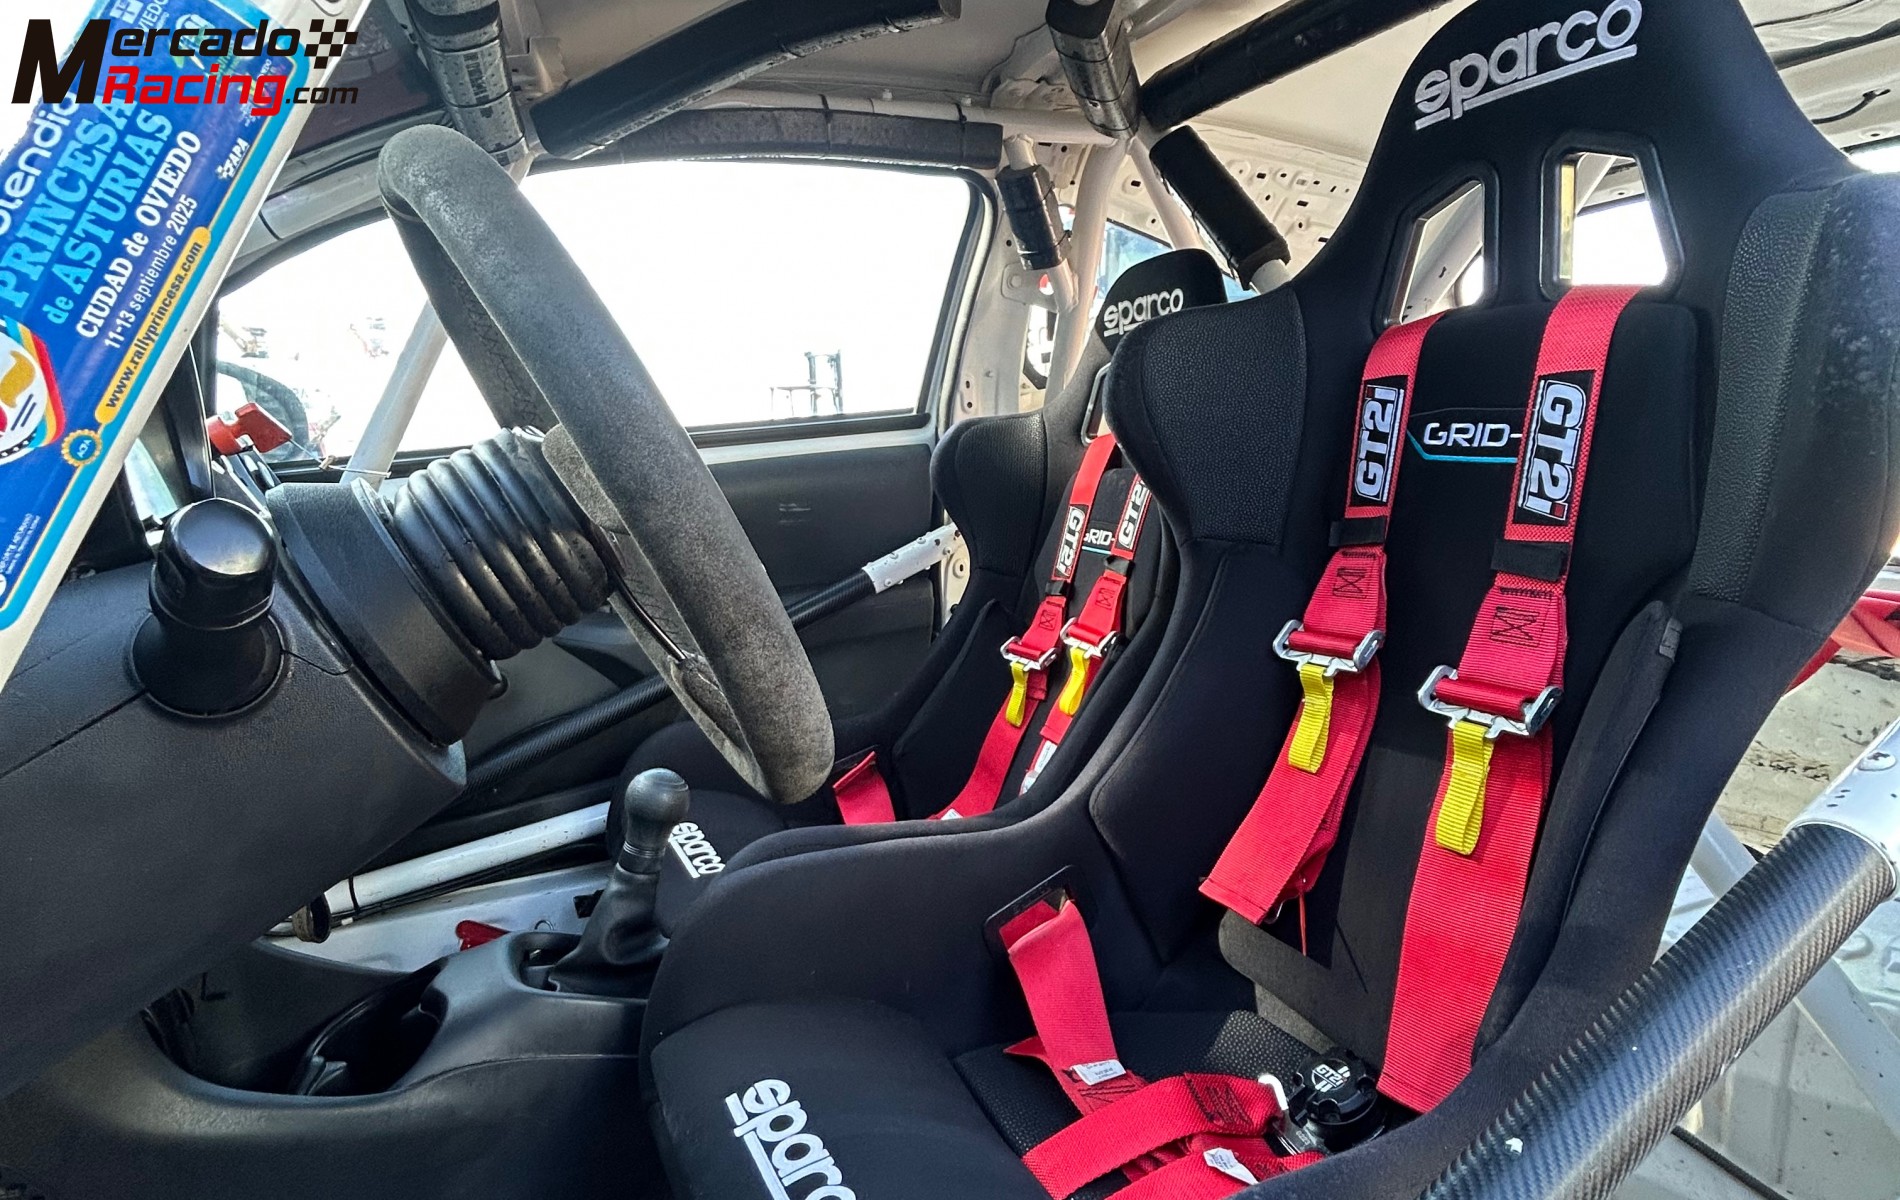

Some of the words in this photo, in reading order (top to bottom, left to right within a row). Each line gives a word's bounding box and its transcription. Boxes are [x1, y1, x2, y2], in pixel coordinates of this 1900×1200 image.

[1415, 0, 1643, 130] sparco
[0, 97, 140, 309] PRINCESA
[51, 108, 173, 296] ASTURIAS
[76, 257, 134, 340] CIUDAD
[121, 231, 149, 259] de
[136, 131, 201, 227] OVIEDO
[104, 310, 136, 349] 11-13
[130, 234, 177, 312] septiembre
[166, 194, 198, 240] 2025
[45, 296, 75, 324] de
[106, 241, 203, 409] www.rallyprincesa.com
[1103, 288, 1184, 337] sparco
[1354, 385, 1398, 500] GT2i
[1523, 380, 1586, 520] GT2i
[668, 821, 726, 878] sparco
